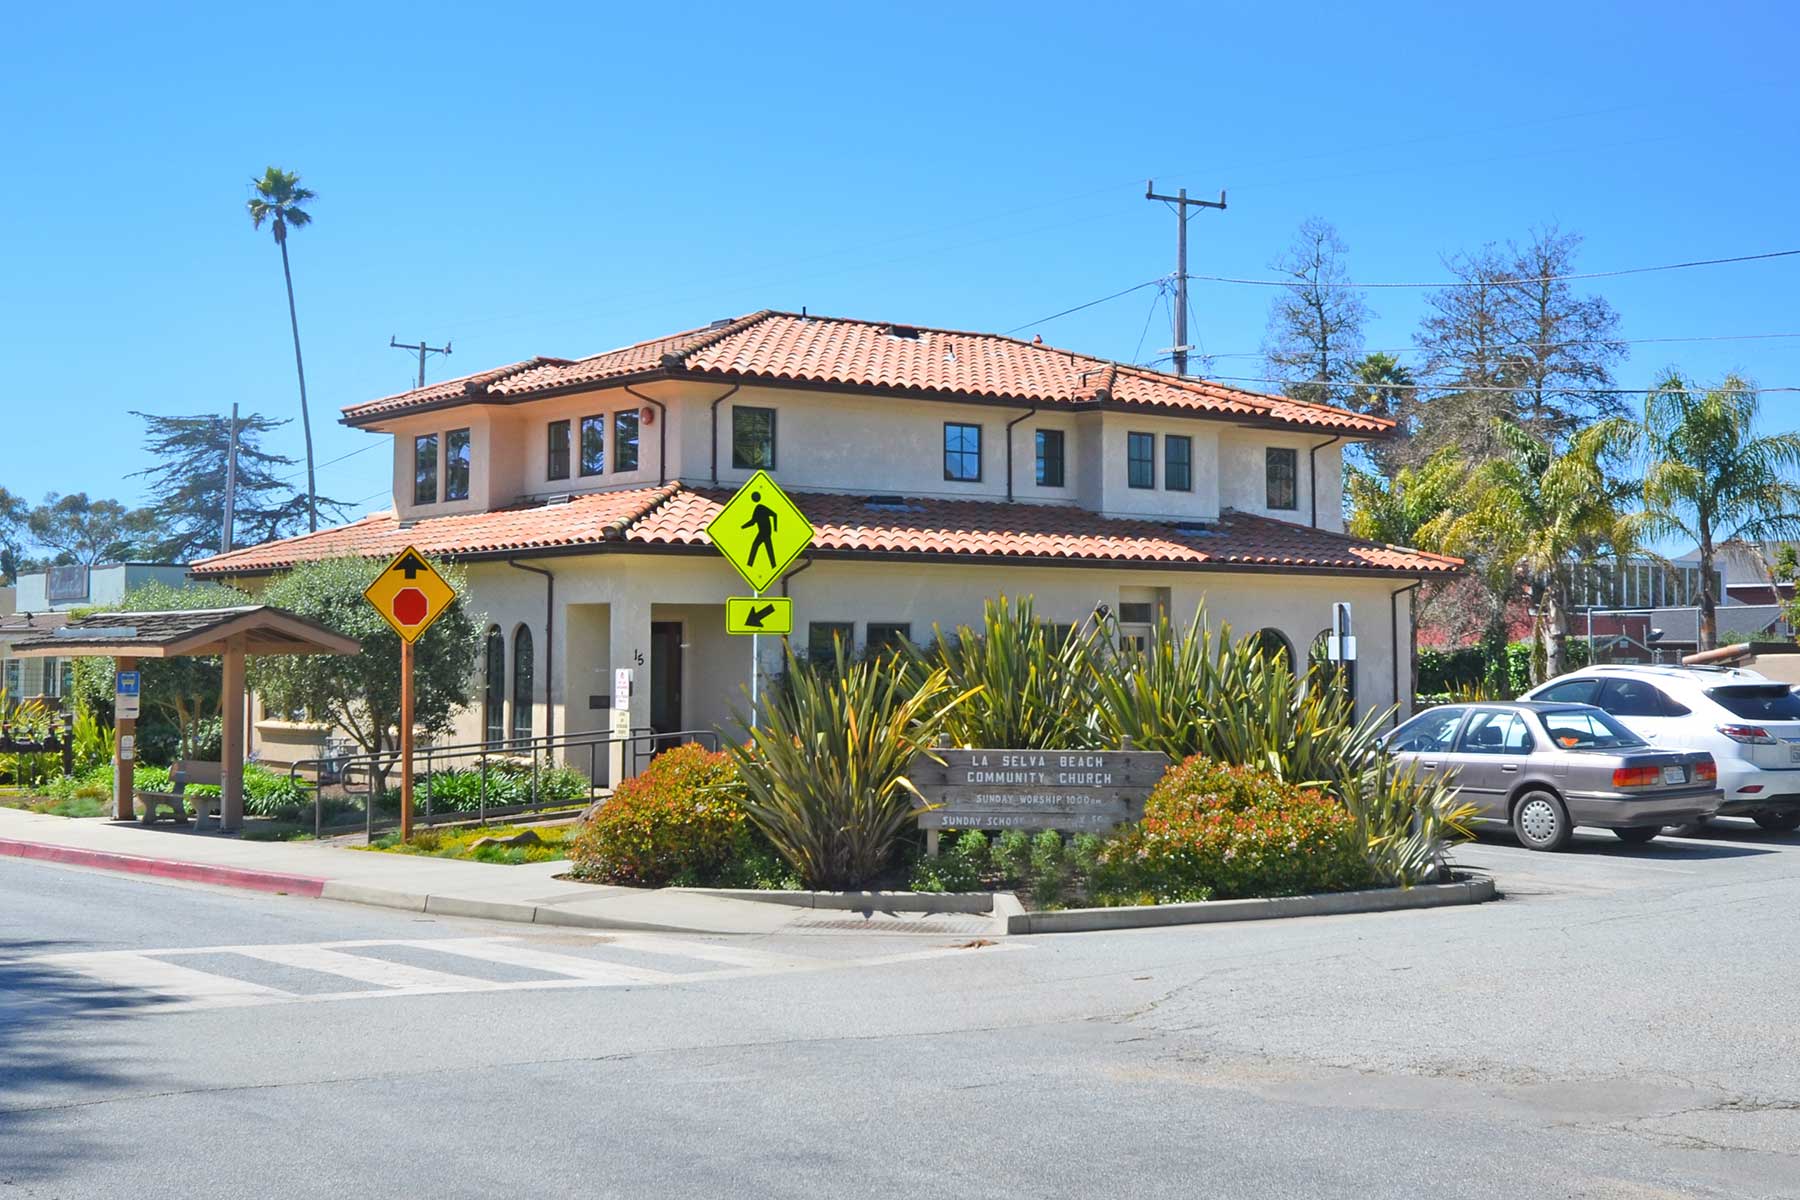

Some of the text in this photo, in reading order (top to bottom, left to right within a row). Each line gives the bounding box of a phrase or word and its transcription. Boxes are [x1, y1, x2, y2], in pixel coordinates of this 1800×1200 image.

[633, 648, 645, 666] 15
[972, 755, 1103, 768] LA SELVA BEACH
[967, 772, 1112, 785] COMMUNITY CHURCH
[975, 794, 1014, 805] SUNDAY
[1020, 794, 1062, 805] WORSHIP
[941, 815, 981, 827] SUNDAY
